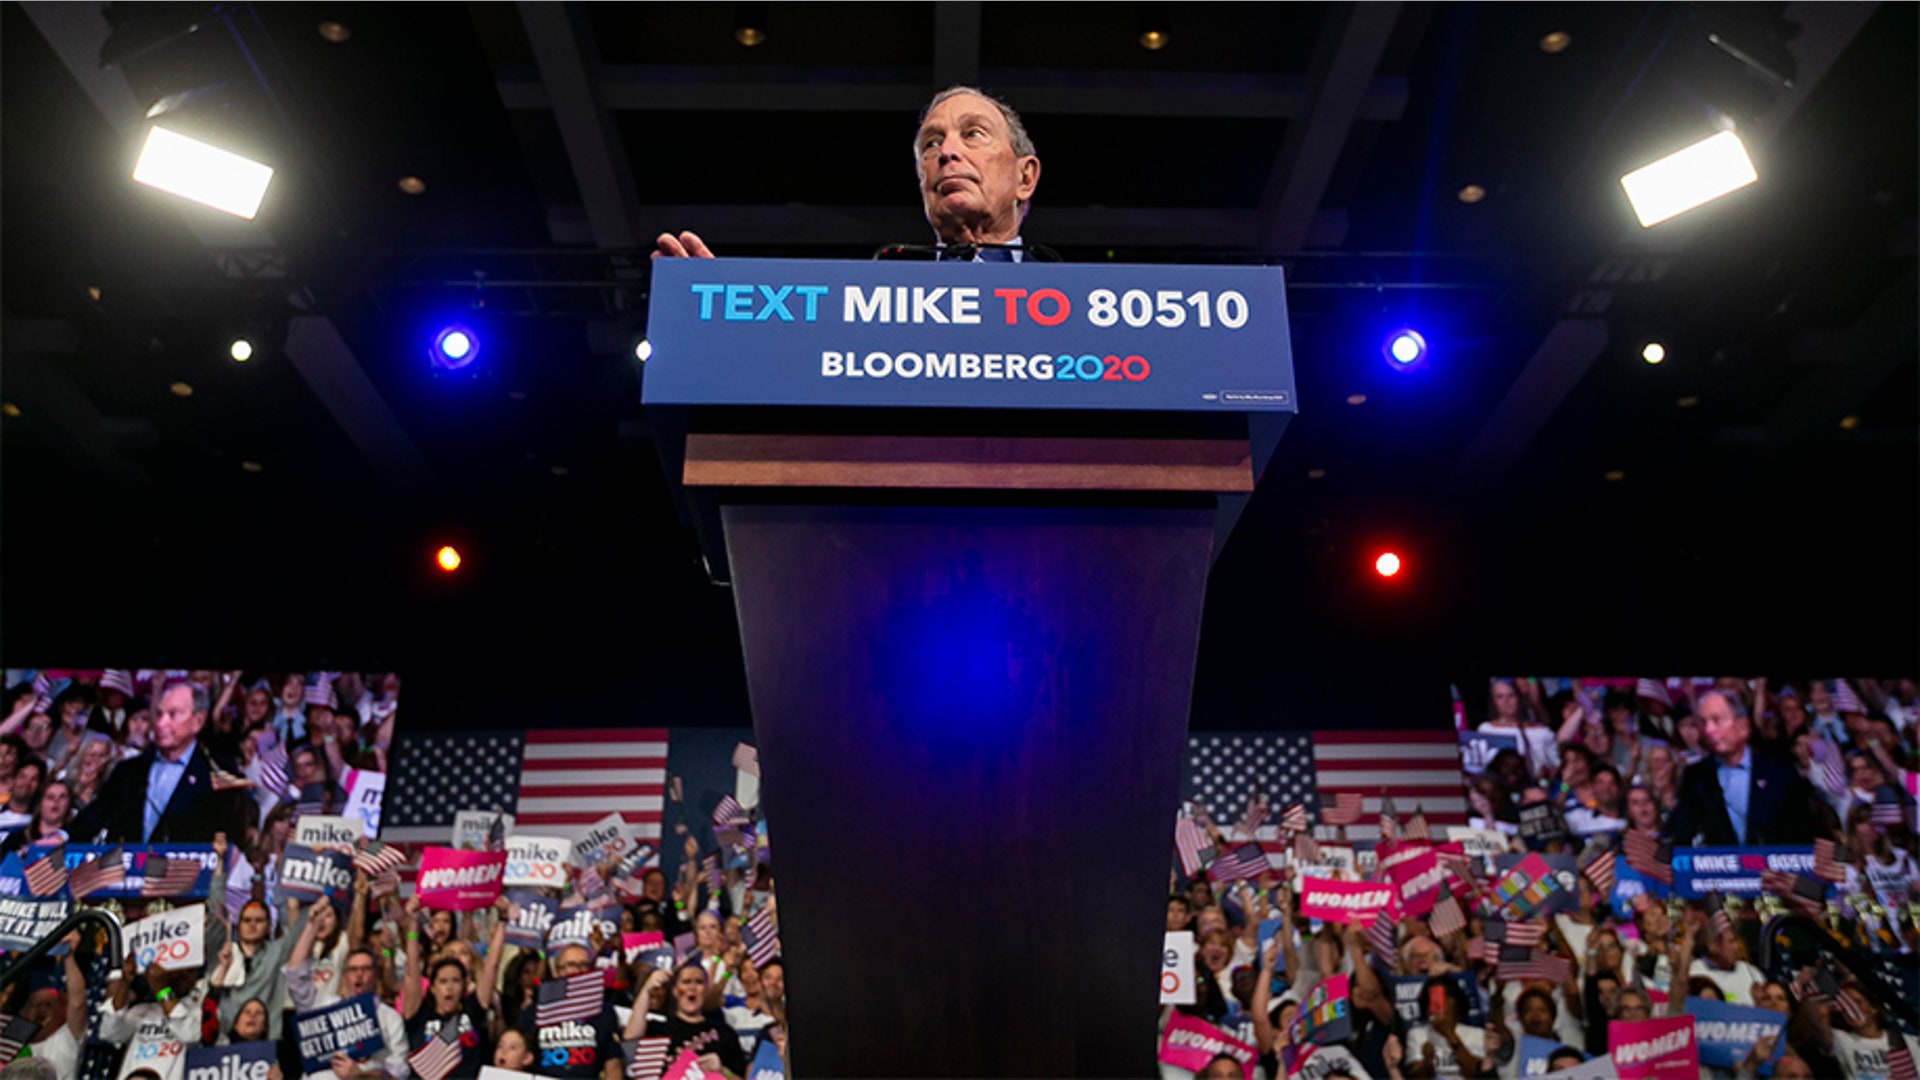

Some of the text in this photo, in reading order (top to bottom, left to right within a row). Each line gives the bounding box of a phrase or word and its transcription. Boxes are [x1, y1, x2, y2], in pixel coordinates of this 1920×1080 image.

[691, 284, 1249, 328] TEXT MIKE TO 80510
[821, 351, 1151, 382] BLOOMBERG2020
[302, 823, 354, 844] mike
[574, 824, 619, 855] mike
[283, 855, 351, 891] mike
[421, 863, 502, 890] WOMEN
[1306, 889, 1392, 911] WOMEN
[129, 920, 190, 949] mike
[328, 1002, 368, 1030] WILL
[539, 1021, 596, 1042] mike
[1168, 1028, 1253, 1062] WOMEN
[1616, 1027, 1691, 1063] WOMEN
[188, 1054, 270, 1080] mike
[541, 1047, 595, 1067] 2020
